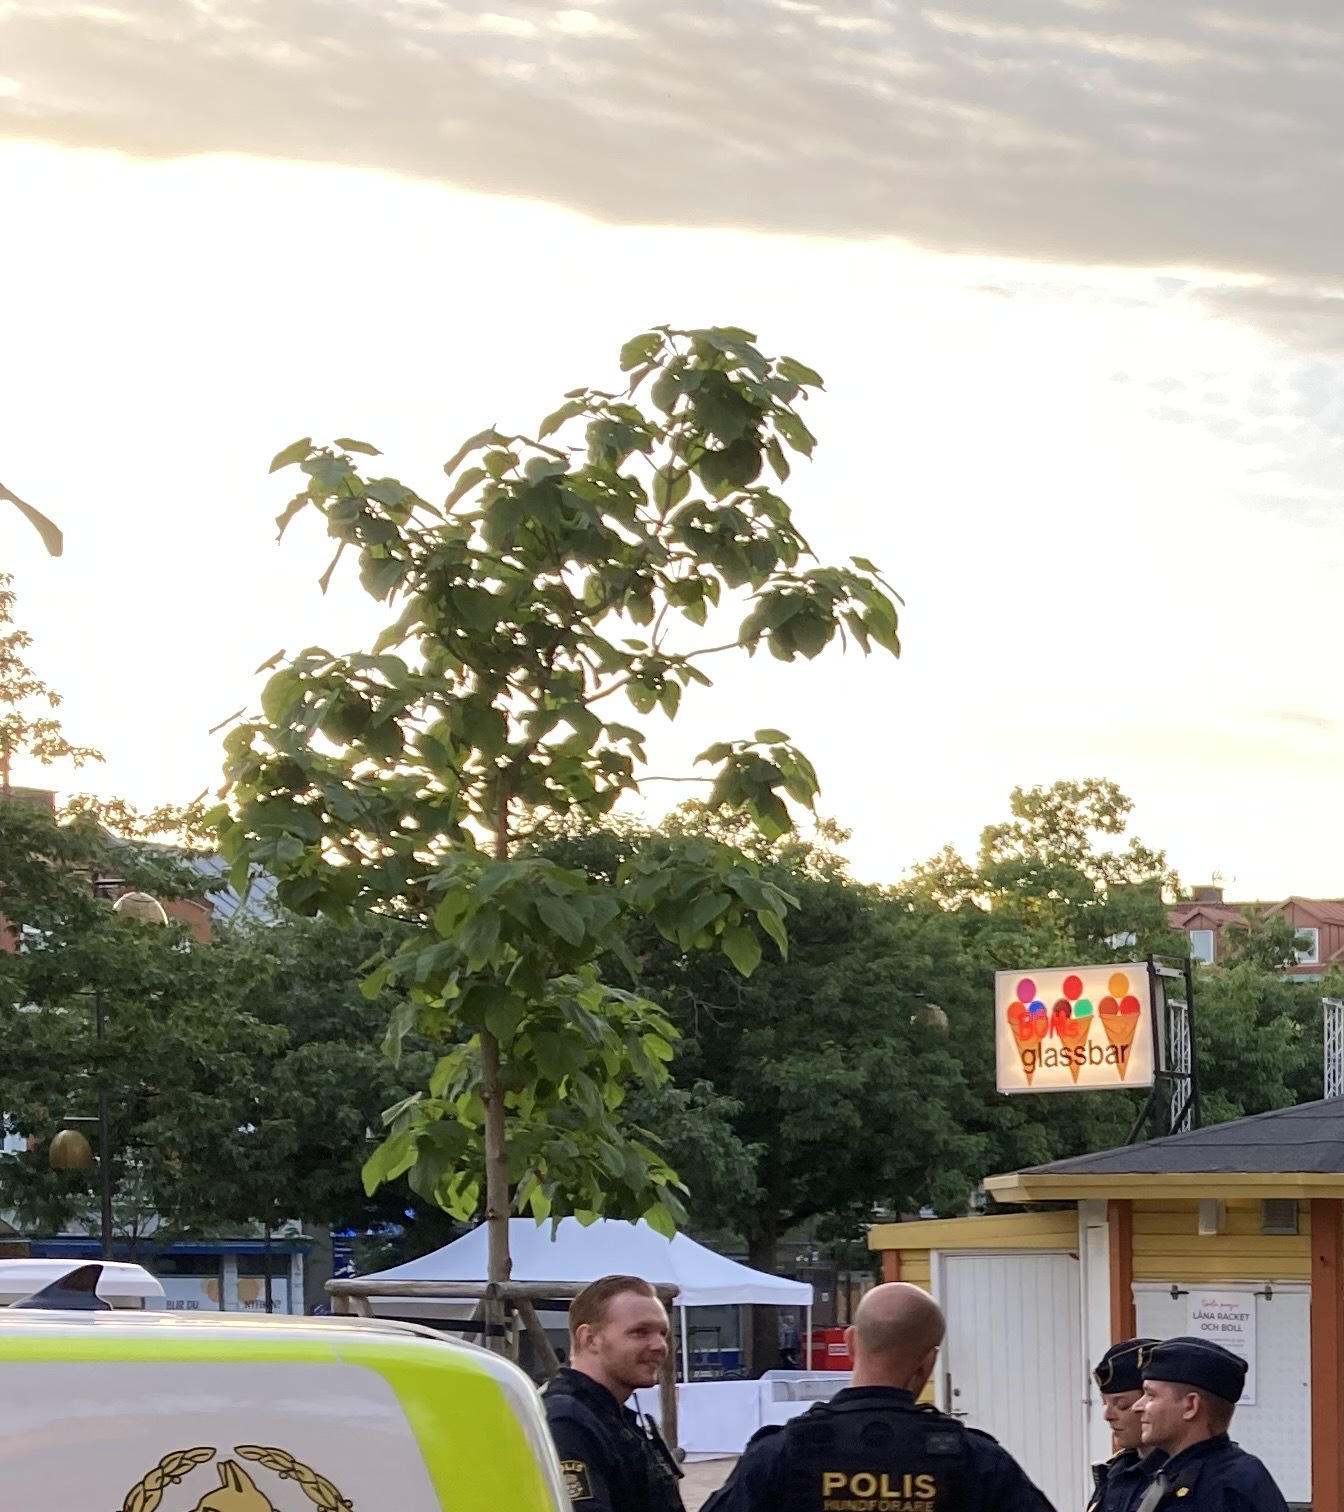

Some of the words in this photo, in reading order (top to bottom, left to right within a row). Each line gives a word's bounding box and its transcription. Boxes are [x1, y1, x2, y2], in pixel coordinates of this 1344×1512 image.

[1021, 1039, 1132, 1074] glassbar
[1193, 1310, 1216, 1320] LÅNA
[1217, 1312, 1250, 1321] RACKET
[1201, 1323, 1219, 1331] OCH
[1221, 1323, 1243, 1332] BOLL
[822, 1472, 937, 1499] POLIS
